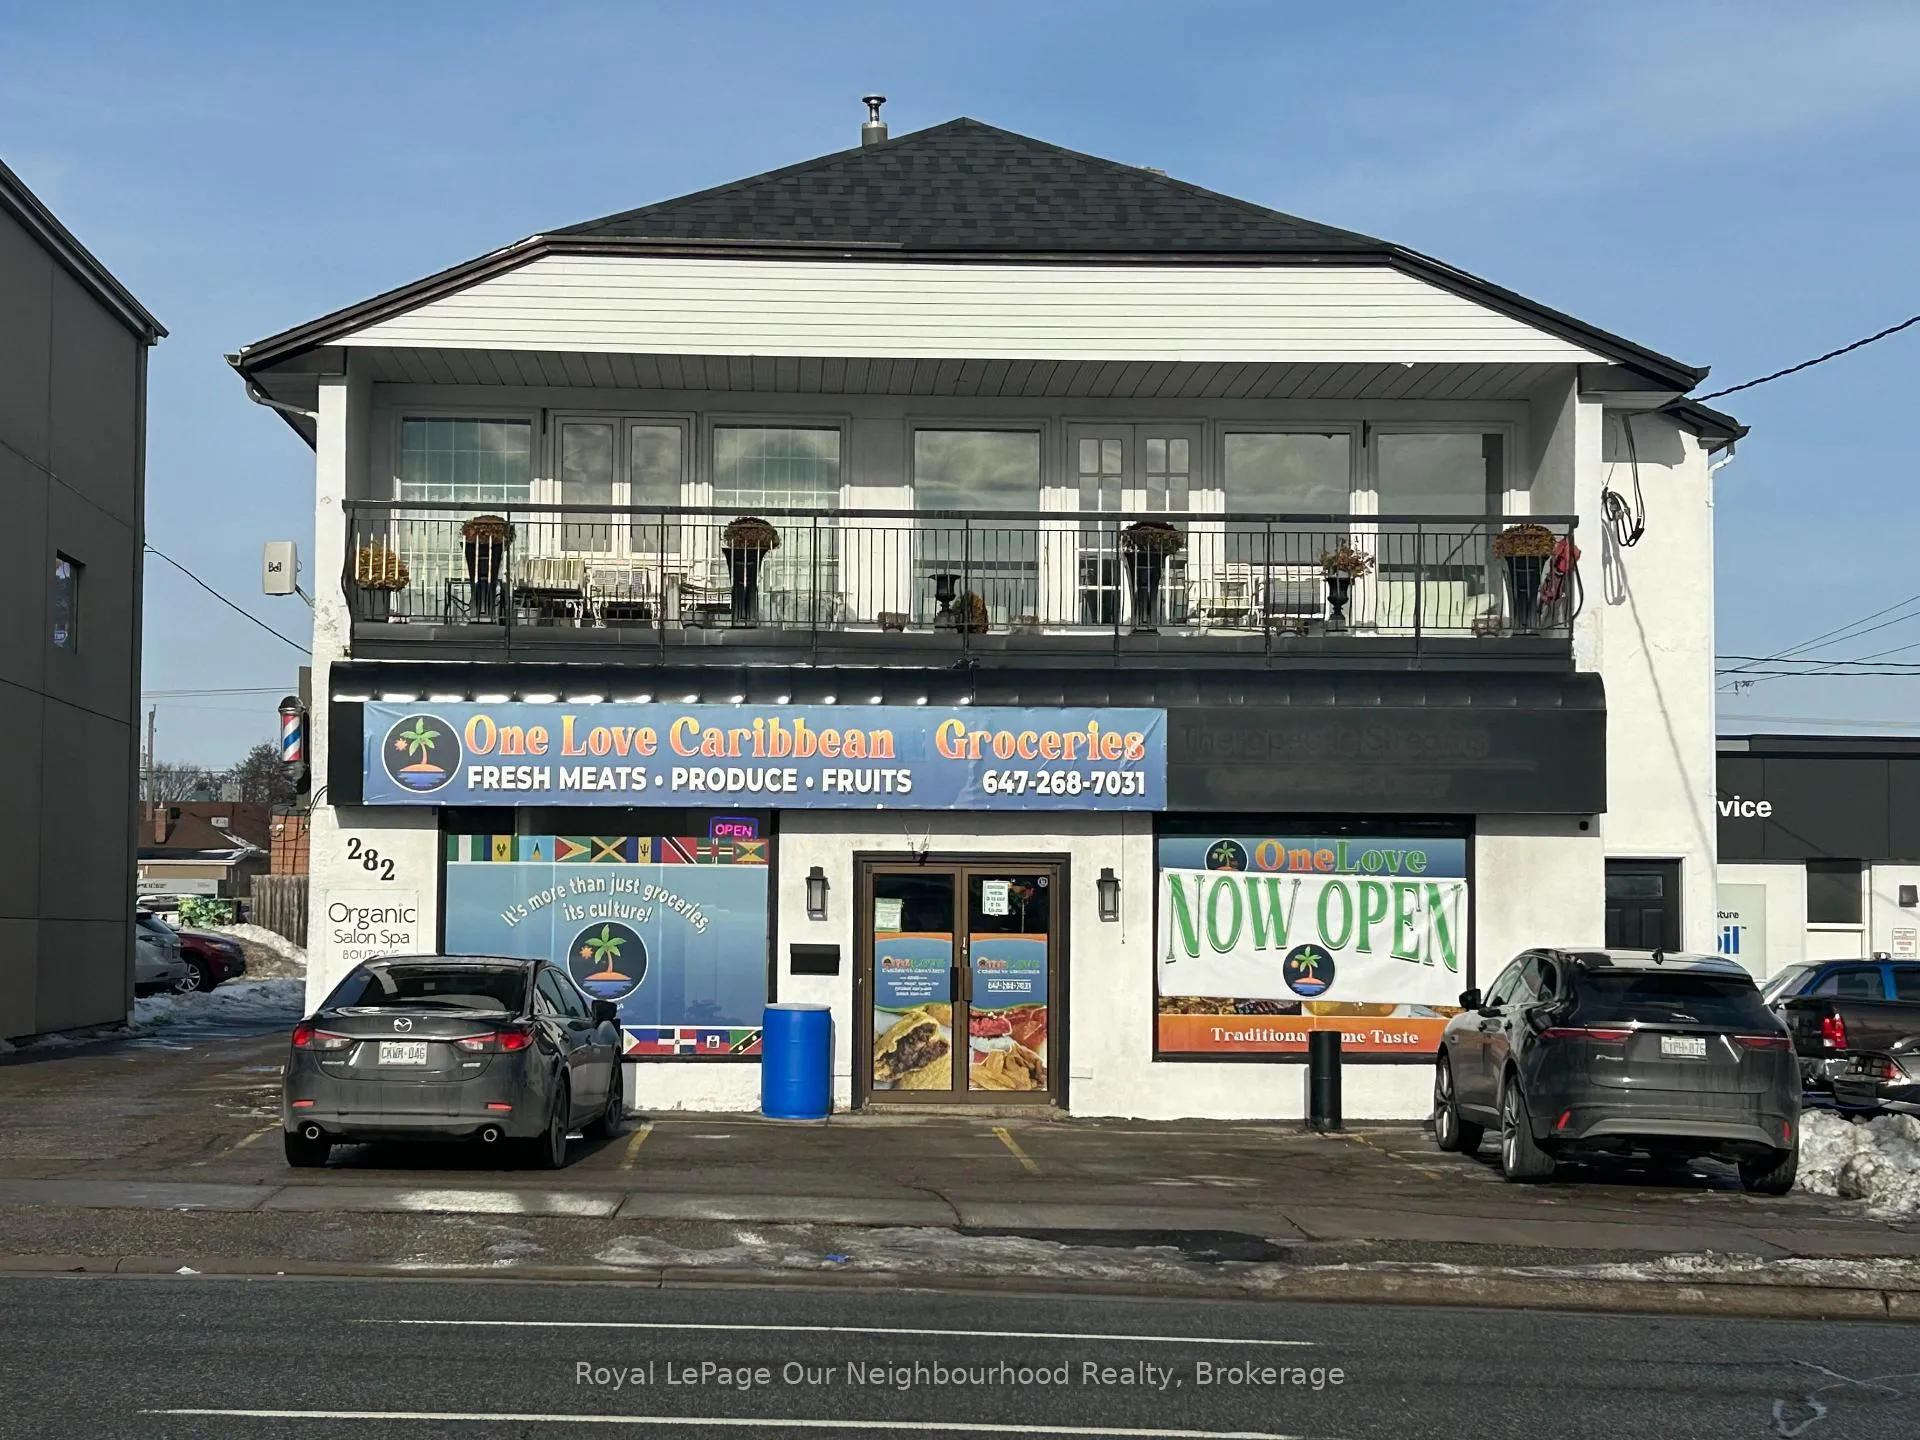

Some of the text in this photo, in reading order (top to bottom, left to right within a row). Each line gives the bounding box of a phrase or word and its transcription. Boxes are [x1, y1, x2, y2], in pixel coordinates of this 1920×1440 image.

[464, 714, 1145, 761] One Love Caribbean Groceries
[467, 766, 912, 794] FRESH MEATS PRODUCE FRUITS
[982, 769, 1145, 795] 647-268-7031
[1717, 795, 1772, 818] vice
[715, 823, 752, 838] OPEN
[347, 837, 395, 880] 282
[1255, 839, 1427, 873] OneLove
[329, 902, 416, 930] Organic
[501, 872, 711, 934] It's more than just groceries,
[563, 900, 653, 923] its culture!
[1717, 910, 1739, 919] ture
[1165, 874, 1464, 973] NOW OPEN
[333, 929, 410, 948] Salon Spa
[1211, 1028, 1309, 1042] Traditiona
[1370, 1030, 1419, 1044] Taste
